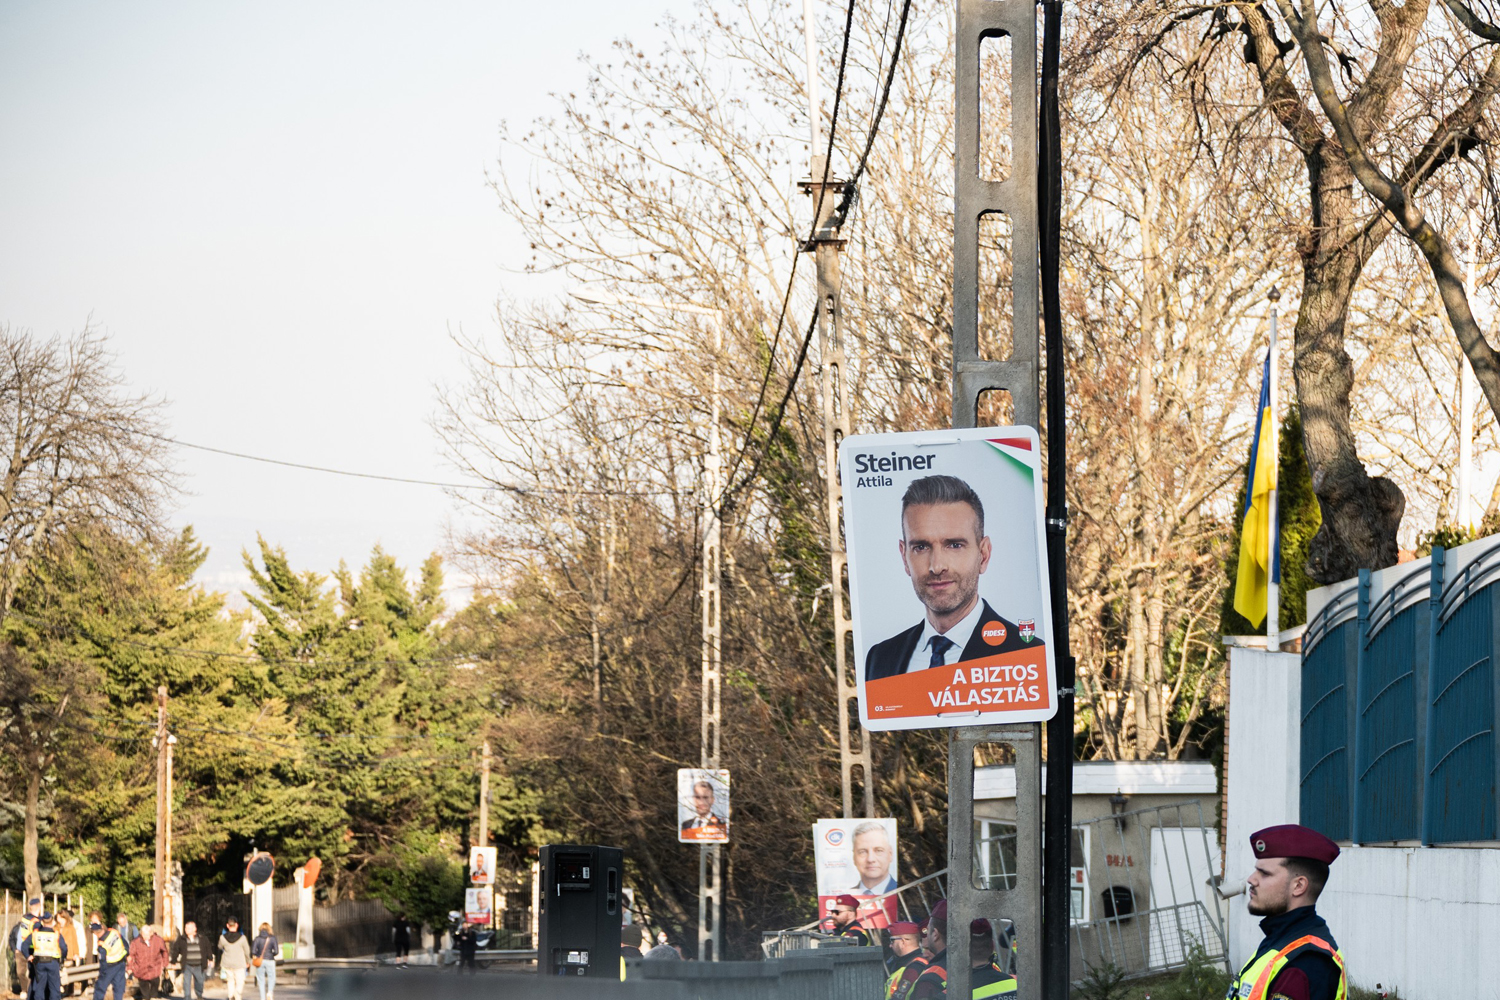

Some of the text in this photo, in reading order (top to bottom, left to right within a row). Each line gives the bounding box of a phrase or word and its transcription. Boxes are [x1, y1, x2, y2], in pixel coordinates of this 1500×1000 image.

[855, 452, 936, 473] Steiner
[857, 475, 893, 488] Attila
[983, 629, 1006, 637] FIDESZ
[952, 664, 1039, 685] A BIZTOS
[928, 682, 1040, 708] VÁLASZTÁS
